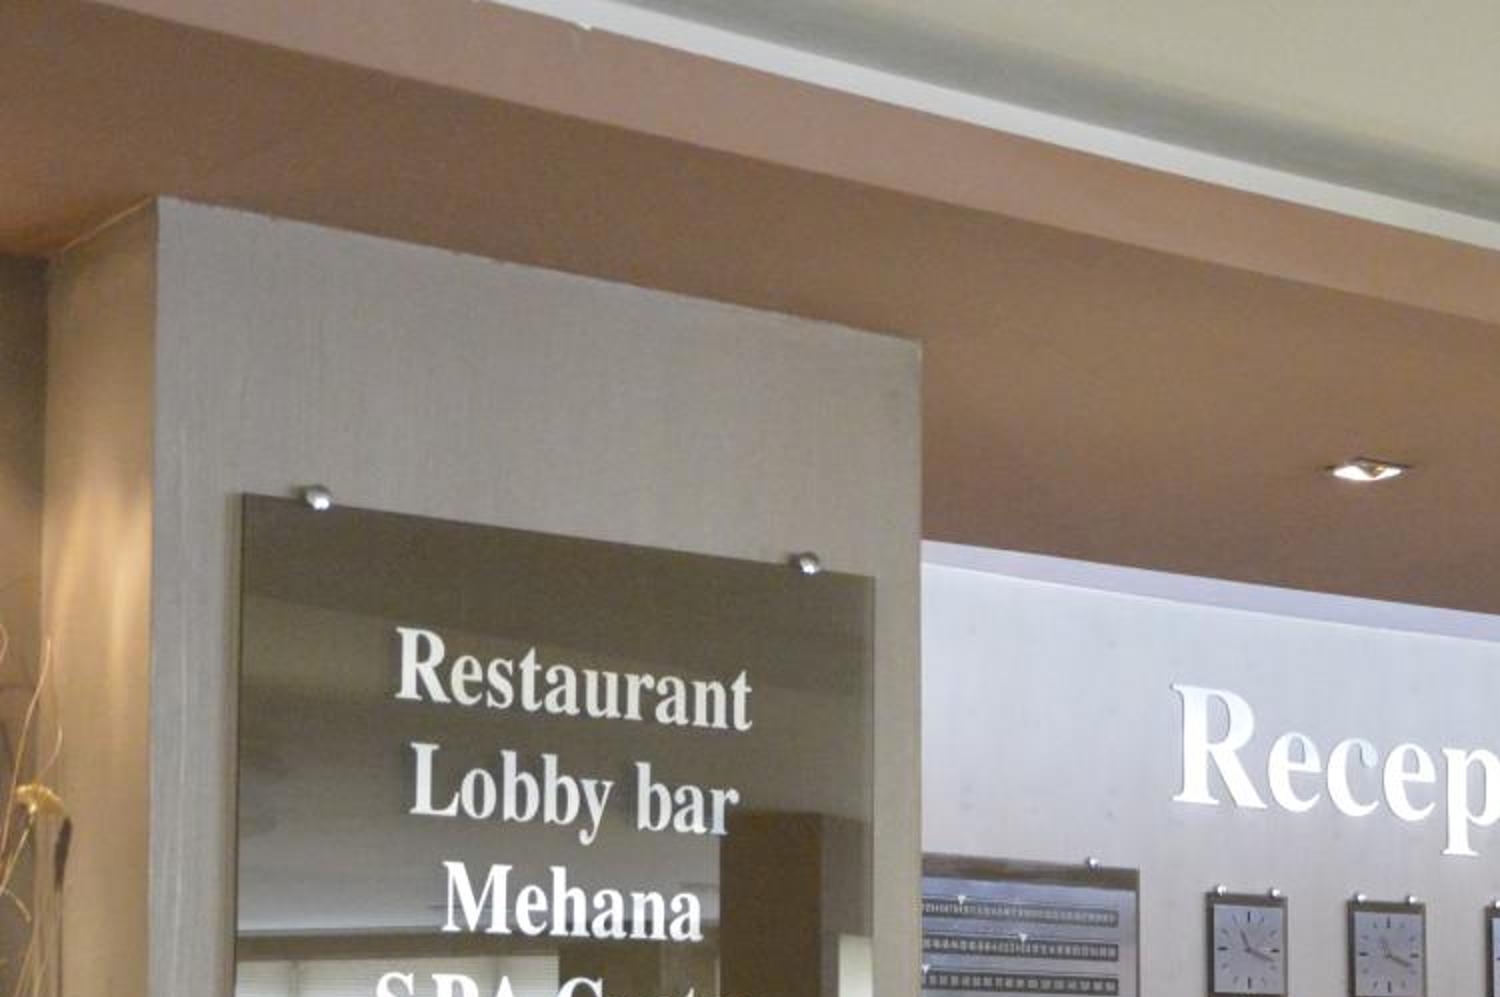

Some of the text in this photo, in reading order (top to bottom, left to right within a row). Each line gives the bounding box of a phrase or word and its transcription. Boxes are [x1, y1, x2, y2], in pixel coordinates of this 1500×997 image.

[395, 625, 754, 732] Restaurant
[409, 741, 740, 846] Lobby bar
[441, 859, 704, 942] Mehana
